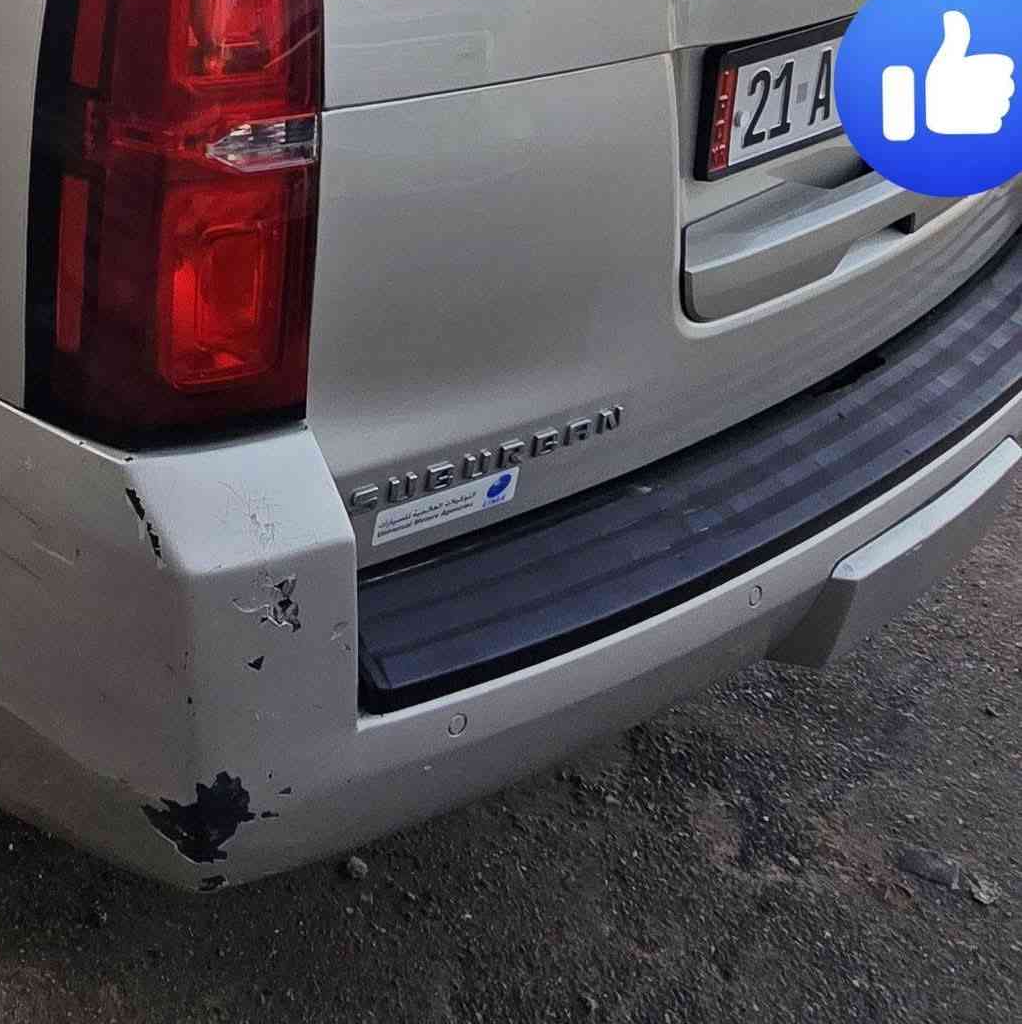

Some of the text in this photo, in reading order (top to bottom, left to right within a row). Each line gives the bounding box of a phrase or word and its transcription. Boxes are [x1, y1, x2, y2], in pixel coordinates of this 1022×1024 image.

[742, 60, 795, 148] 21
[808, 48, 833, 126] A
[351, 403, 625, 508] SUBURBAN
